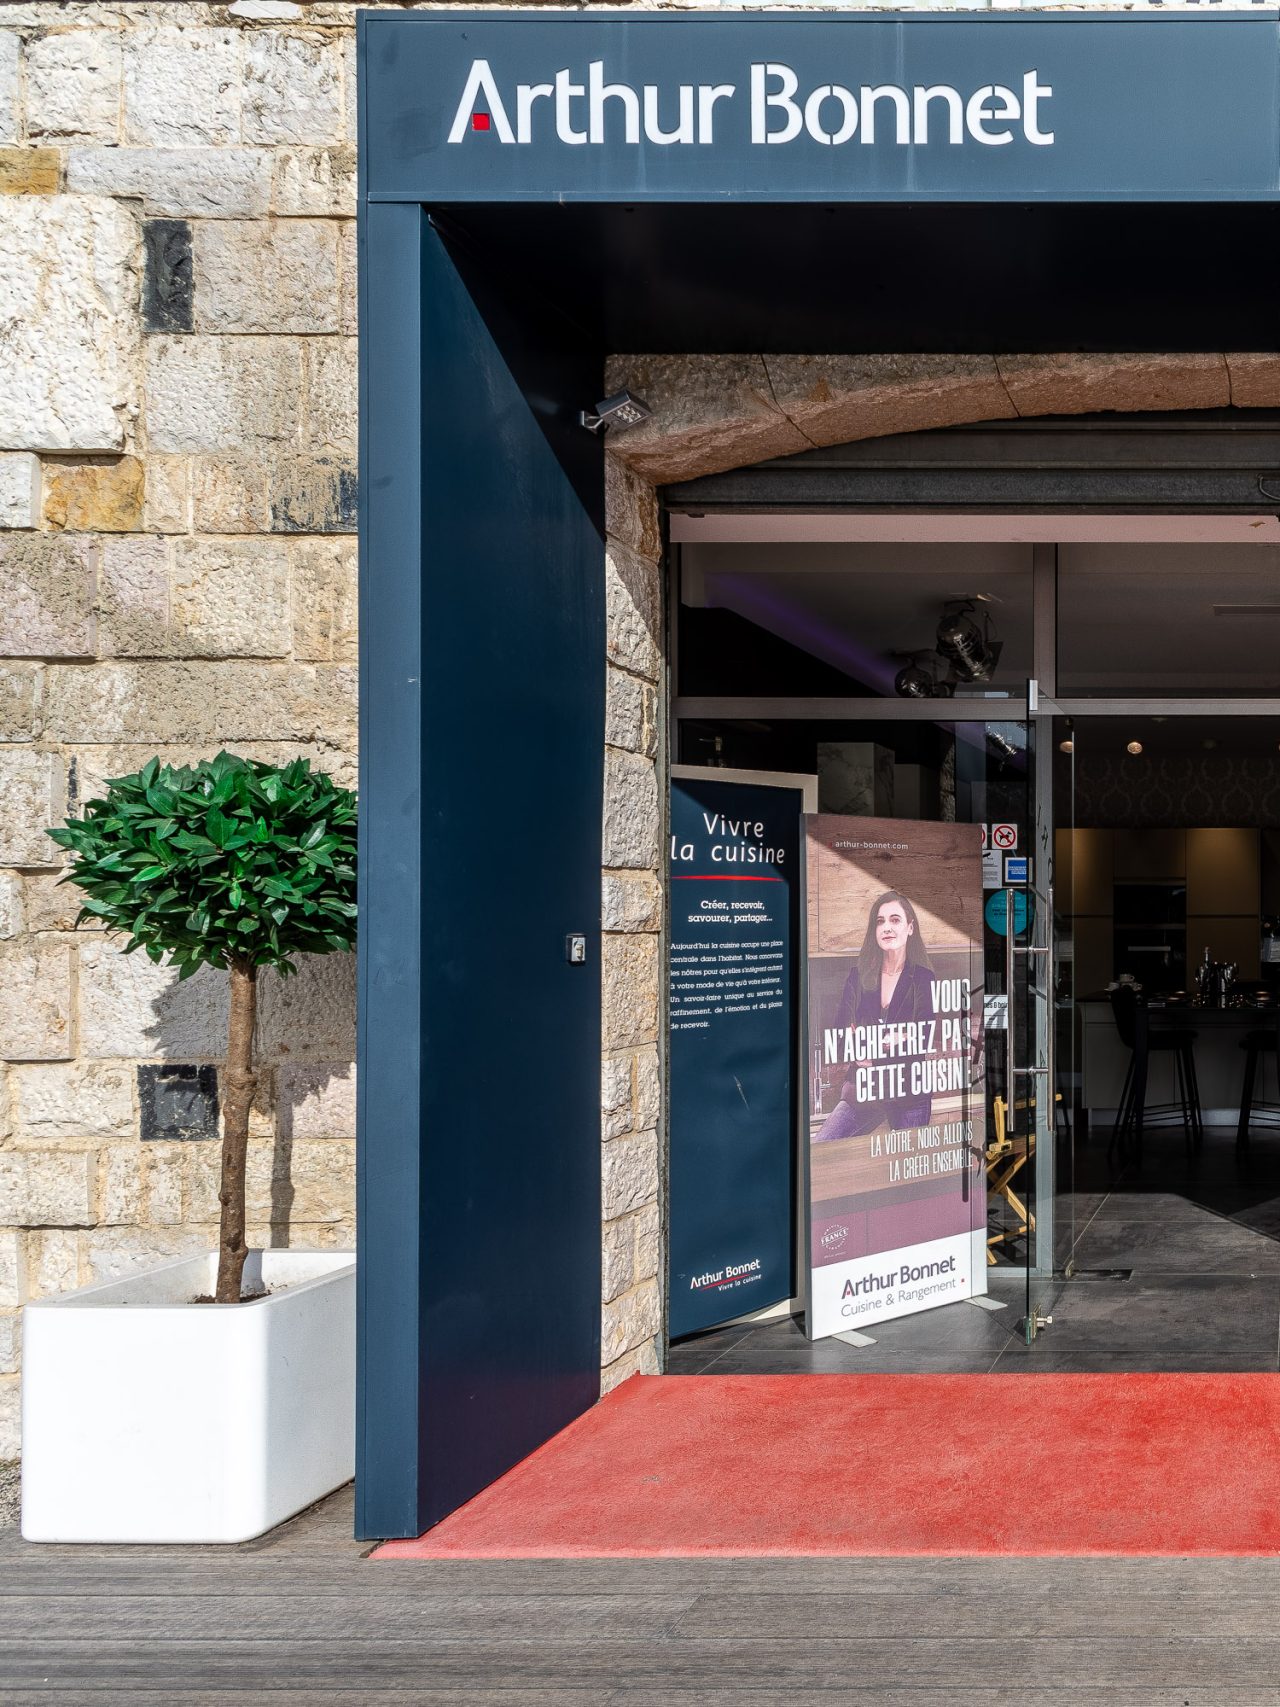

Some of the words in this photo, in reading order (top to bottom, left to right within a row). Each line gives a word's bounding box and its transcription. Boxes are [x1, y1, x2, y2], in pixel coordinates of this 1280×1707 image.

[447, 58, 735, 145] Arthur
[751, 61, 1054, 146] Bonnet
[703, 812, 764, 838] Vivre
[671, 835, 695, 861] la
[711, 841, 785, 864] cuisine
[835, 840, 909, 850] arthur-bonnet.com
[700, 900, 729, 911] Créer,
[731, 901, 765, 911] recevoir,
[688, 914, 732, 924] savourer,
[671, 942, 710, 951] Aujourd'hui
[681, 968, 702, 976] nôtres
[704, 968, 718, 977] pour
[677, 982, 695, 990] votre
[684, 994, 722, 1003] savoir-faire
[724, 992, 745, 1001] unique
[930, 978, 971, 1014] VOUS
[714, 1006, 723, 1014] de
[824, 1018, 937, 1065] N'ACHÈTEREZ
[942, 1017, 971, 1052] PAS
[856, 1062, 907, 1103] CETTE
[911, 1056, 972, 1096] CUISINE
[870, 1135, 883, 1158] LA
[884, 1128, 915, 1156] VÔTRE,
[918, 1126, 941, 1149] NOUS
[943, 1120, 973, 1146] ALLONS
[889, 1159, 900, 1183] LA
[903, 1152, 930, 1179] CRÉER
[932, 1147, 973, 1175] ENSEMBLE
[820, 1228, 848, 1245] FRANCE
[690, 1270, 724, 1290] Arthur
[726, 1258, 761, 1278] Bonnet
[718, 1283, 733, 1292] Vivre
[742, 1274, 762, 1285] cuisine
[841, 1272, 899, 1300] Arthur
[900, 1255, 956, 1284] Bonnet
[840, 1299, 882, 1318] Cuisine
[886, 1293, 895, 1305] &
[898, 1278, 957, 1302] Rangement
